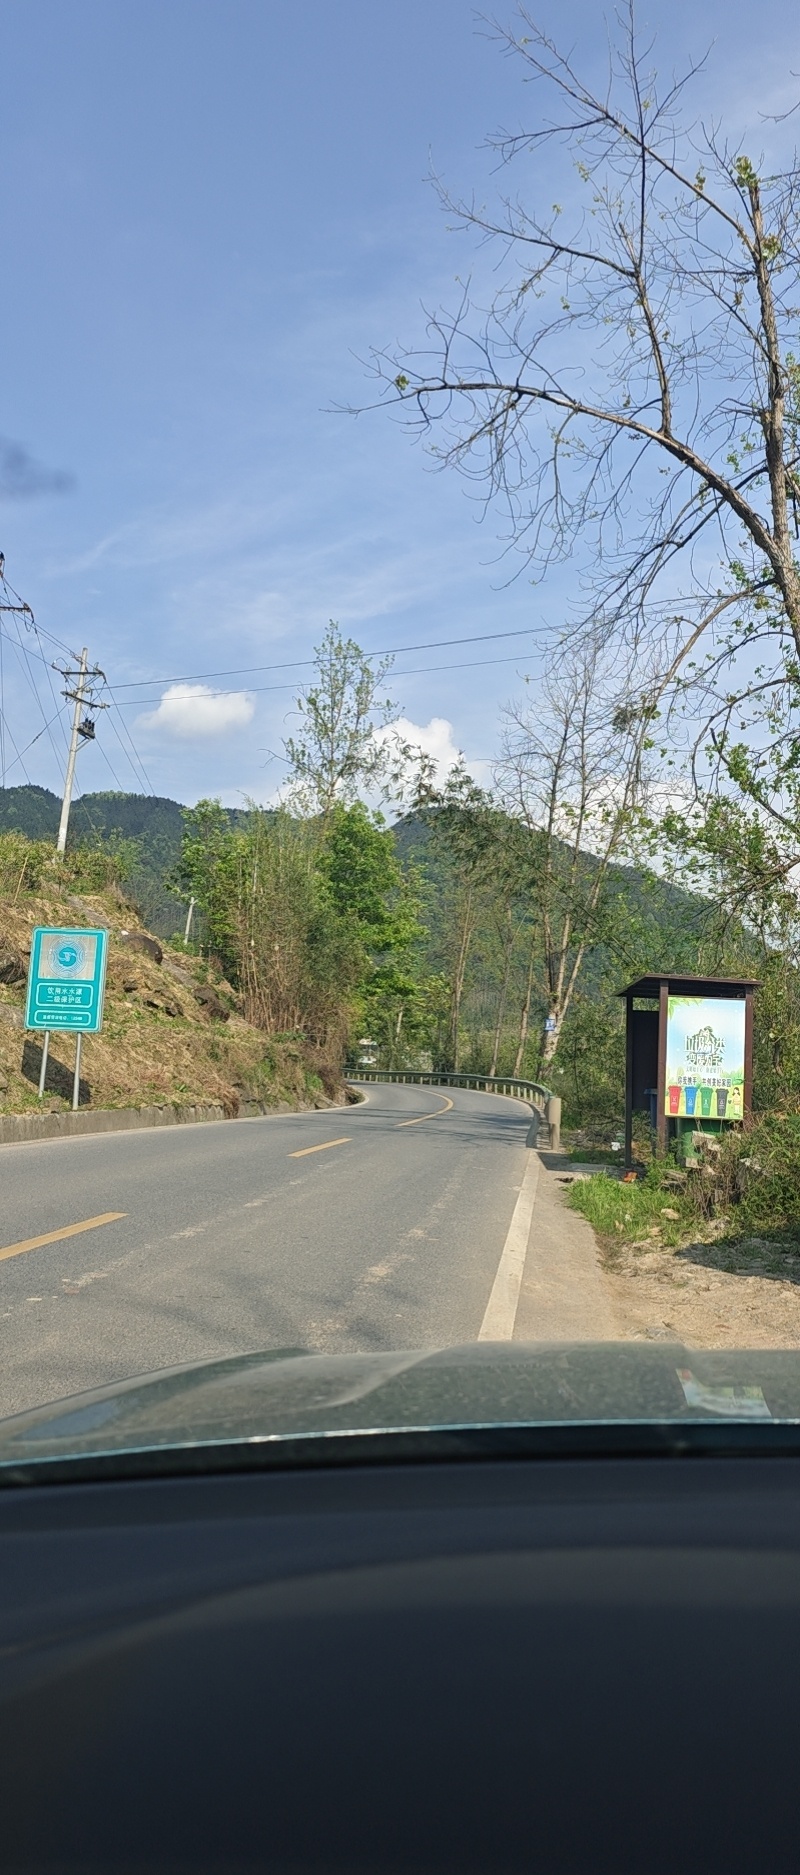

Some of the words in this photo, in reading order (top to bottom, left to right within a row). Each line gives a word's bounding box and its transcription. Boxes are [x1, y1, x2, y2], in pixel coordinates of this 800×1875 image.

[47, 987, 82, 995] 饮用水水源
[46, 995, 82, 1003] 二级保护区
